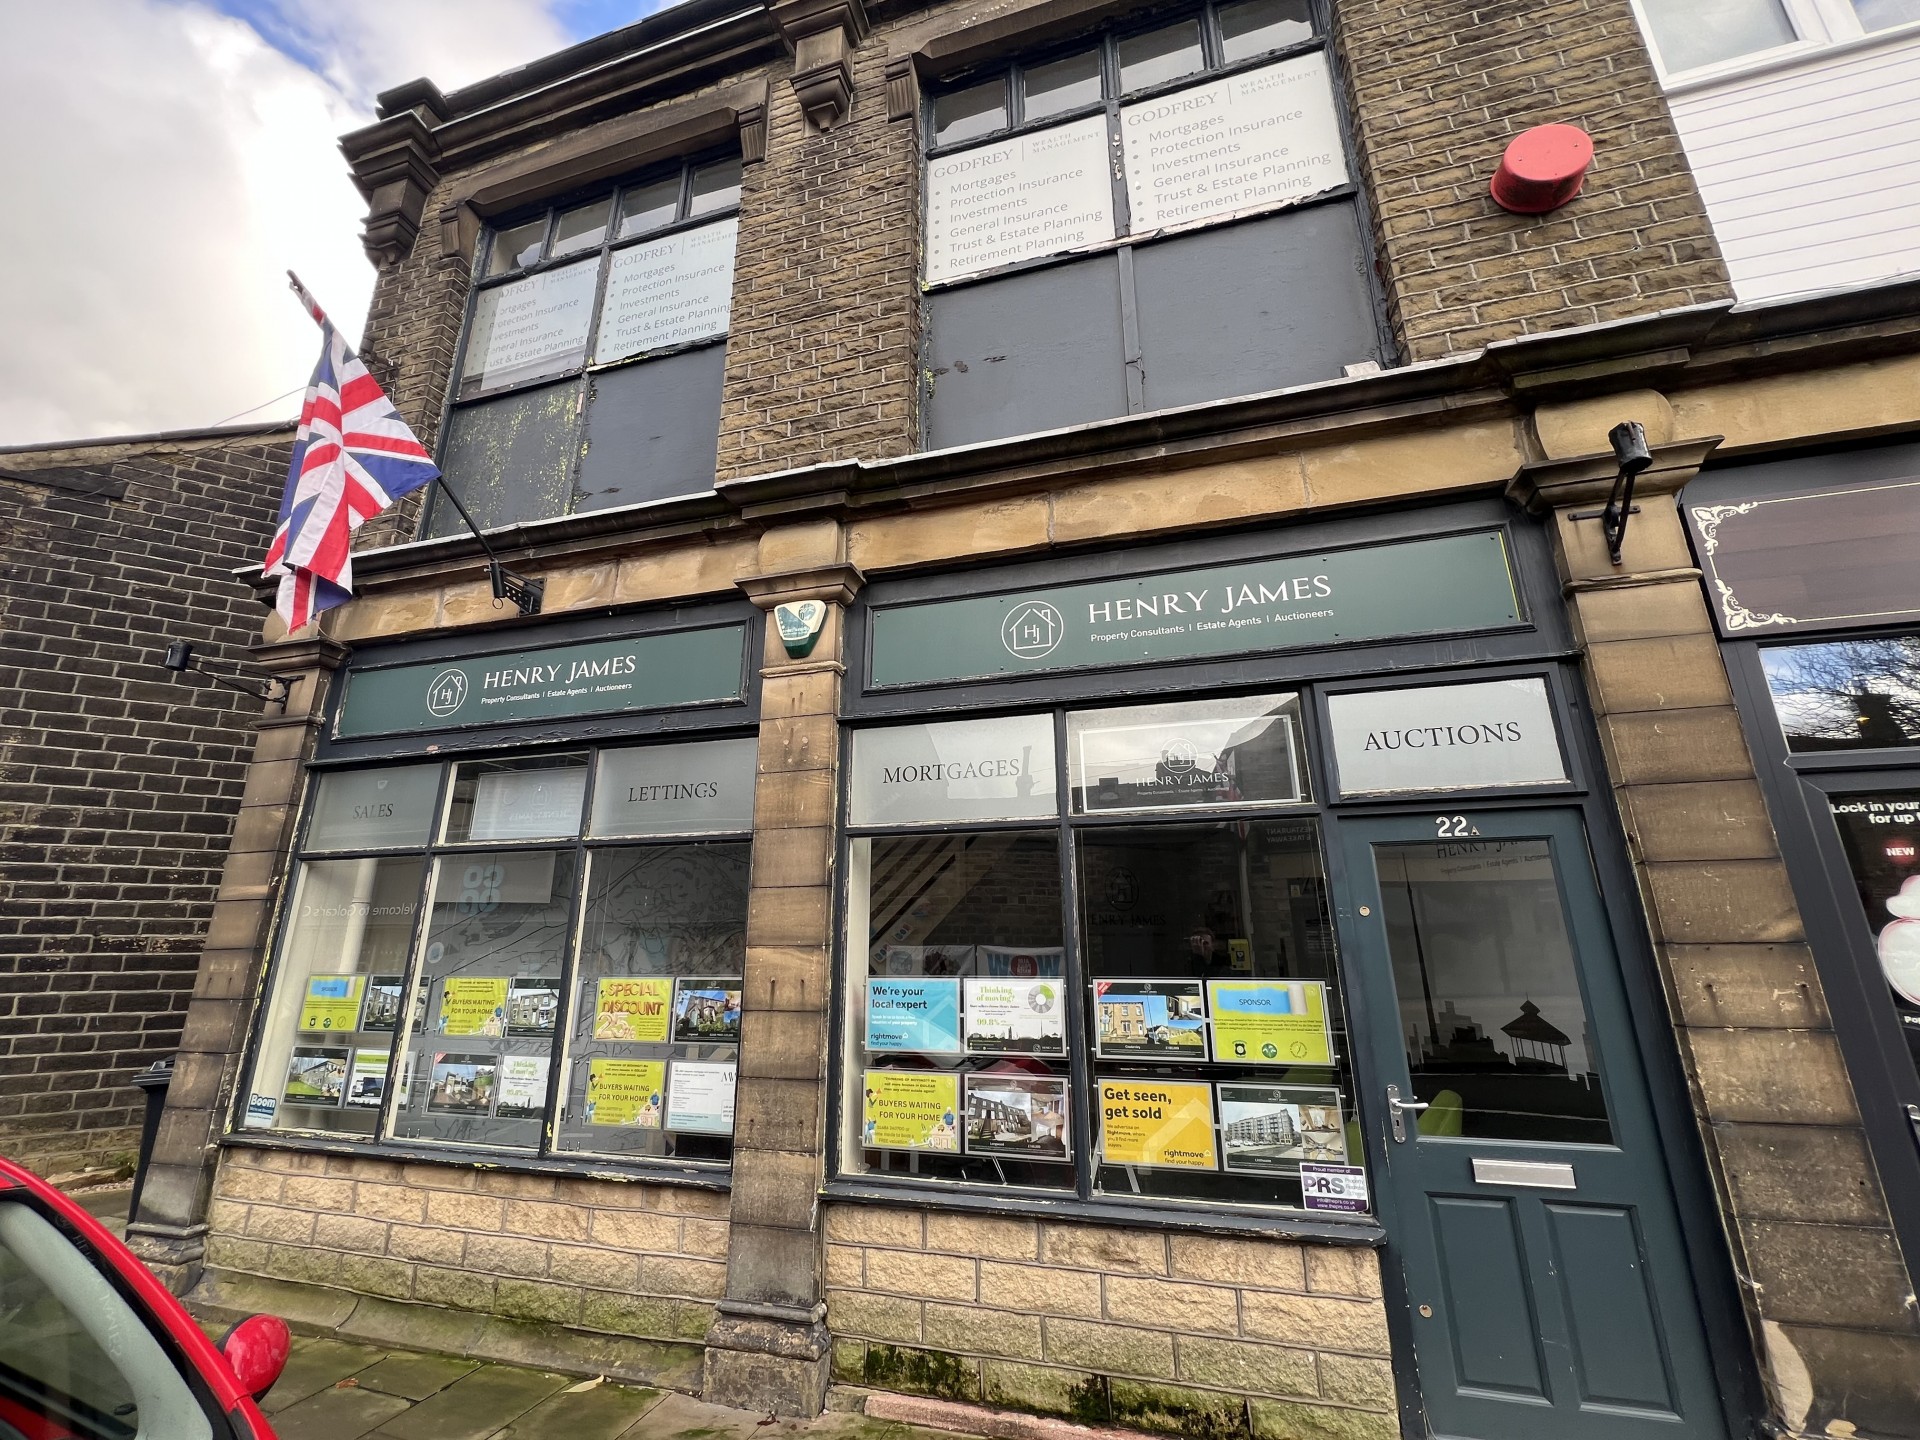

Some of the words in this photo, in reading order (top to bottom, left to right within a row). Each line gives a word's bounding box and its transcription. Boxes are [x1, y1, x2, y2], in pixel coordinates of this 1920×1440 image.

[1240, 72, 1284, 89] WEALTH
[1241, 69, 1319, 96] MANAGEMENT
[1128, 92, 1218, 126] GODFREY
[1150, 114, 1224, 141] Mortgages
[1151, 130, 1223, 157] Protection
[1230, 109, 1303, 136] Insurance
[1032, 133, 1071, 148] WEALTH
[1033, 131, 1100, 154] MANAGEMENT
[934, 149, 1013, 178] GODFREY
[1152, 143, 1240, 173] Investments
[1154, 164, 1209, 188] General
[1215, 147, 1289, 172] Insurance
[950, 171, 1016, 194] Mortgages
[951, 186, 1014, 209] Protection
[1020, 168, 1082, 191] Insurance
[1155, 188, 1192, 204] Trust
[1197, 183, 1207, 193] &
[1213, 171, 1257, 190] Estate
[1263, 153, 1331, 177] Planning
[1157, 191, 1239, 220] Retirement
[1244, 175, 1312, 199] Planning
[950, 218, 999, 238] General
[1004, 203, 1068, 225] Insurance
[951, 197, 1027, 222] Investments
[690, 233, 736, 248] MANAGEMEN
[691, 231, 721, 242] WEALTH
[950, 239, 982, 253] Trust
[986, 235, 996, 244] &
[1000, 224, 1039, 241] Estate
[1044, 210, 1102, 231] Planning
[614, 243, 676, 268] GODFREY
[950, 244, 1021, 268] Retirement
[1026, 231, 1084, 251] Planning
[622, 278, 671, 296] Protection
[675, 264, 725, 282] Insurance
[624, 264, 675, 283] Mortgages
[535, 299, 579, 316] Insurance
[618, 307, 656, 324] General
[660, 295, 709, 314] Insurance
[620, 289, 680, 310] Investments
[616, 326, 640, 338] Trust
[655, 315, 685, 329] Estate
[688, 304, 731, 320] Planning
[520, 328, 564, 347] Insurance
[614, 332, 669, 352] Retirement
[672, 321, 717, 338] Planning
[515, 349, 541, 360] Estate
[544, 336, 584, 352] Planning
[1088, 590, 1209, 623] HENRY
[1221, 575, 1332, 613] JAMES
[1024, 625, 1040, 644] HJ
[1090, 633, 1128, 642] Property
[1131, 625, 1184, 638] Consultants
[1197, 621, 1226, 631] Estate
[1228, 617, 1261, 629] Agents
[1274, 609, 1334, 623] Auctioneers
[484, 664, 561, 689] HENRY
[566, 655, 636, 684] JAMES
[441, 688, 452, 705] HJ
[481, 696, 505, 704] Property
[506, 692, 540, 701] Consultants
[567, 687, 587, 696] Agents
[595, 683, 632, 692] Auctioneers
[1363, 721, 1522, 751] AUCTIONS
[882, 758, 1020, 784] MORTGAGES
[1136, 775, 1182, 787] HENRY
[1188, 772, 1229, 785] JAMES
[628, 782, 718, 802] LETTINGS
[353, 804, 393, 819] SALES
[1830, 802, 1868, 813] Lock
[1868, 802, 1884, 811] in
[1886, 802, 1920, 812] your
[1869, 813, 1891, 823] for
[1893, 814, 1915, 824] up
[1886, 847, 1914, 856] NEW
[608, 982, 659, 997] SPECIAL
[873, 986, 899, 995] We're
[902, 989, 924, 998] your
[980, 987, 1012, 995] Thinking
[602, 1000, 664, 1015] DISCOUNT
[872, 1000, 893, 1008] local
[896, 1000, 927, 1011] expert
[596, 1012, 635, 1039] 25%
[977, 1018, 999, 1026] 99.8%
[250, 1093, 276, 1108] Boom
[1104, 1087, 1130, 1100] Get
[1134, 1092, 1172, 1104] seen,
[1105, 1106, 1129, 1120] get
[1132, 1107, 1162, 1119] sold
[1164, 1149, 1204, 1158] rightmove
[1303, 1176, 1345, 1194] PRS
